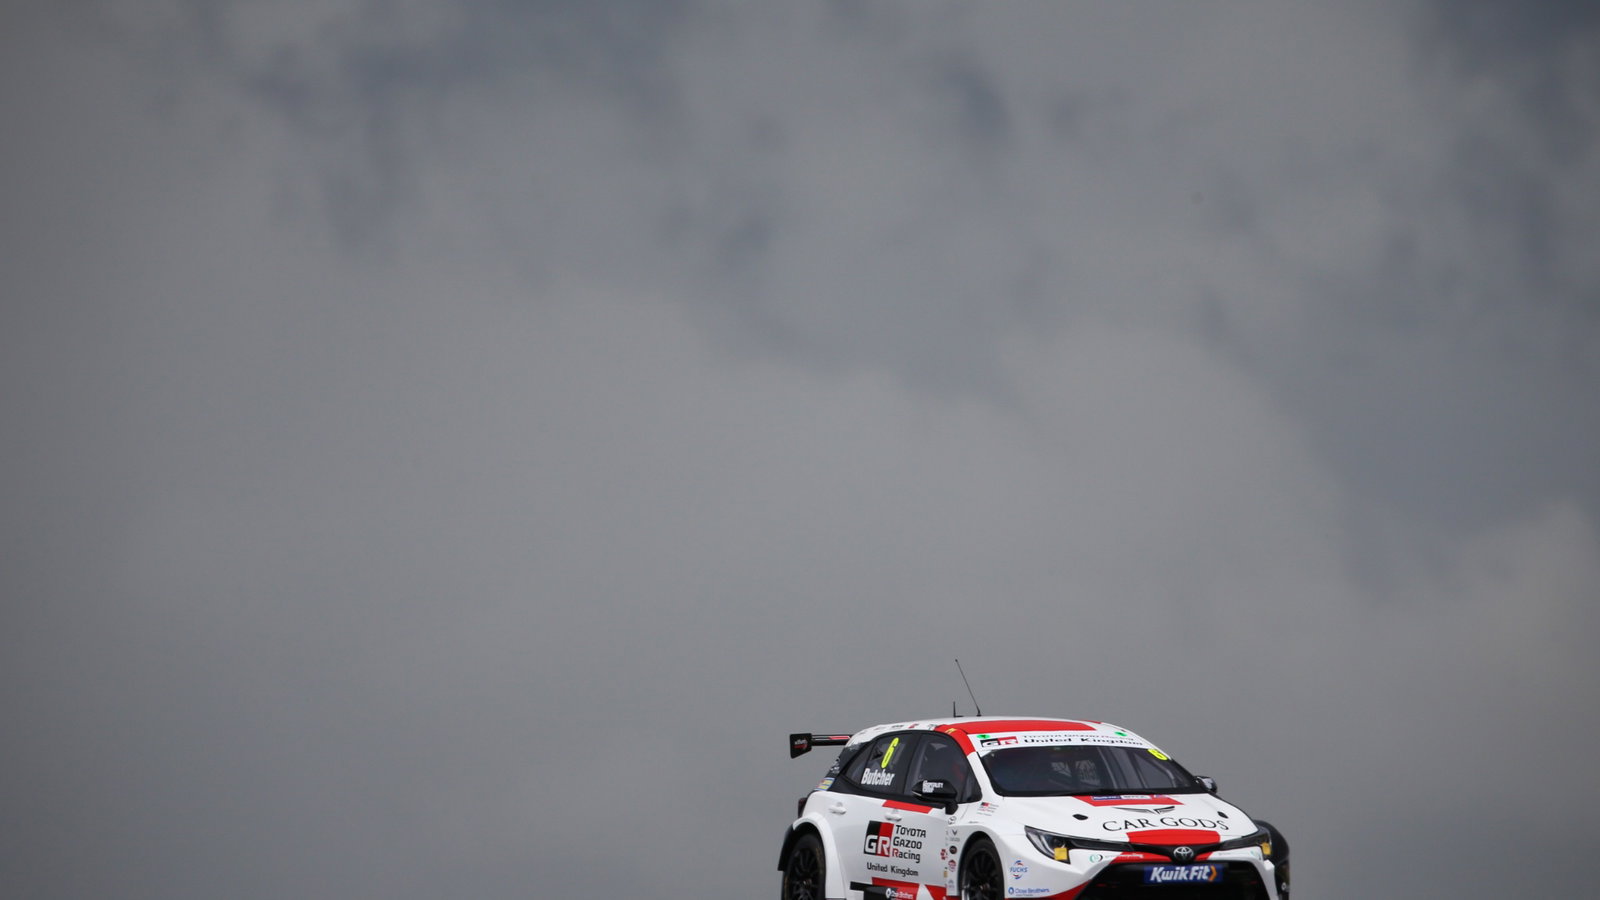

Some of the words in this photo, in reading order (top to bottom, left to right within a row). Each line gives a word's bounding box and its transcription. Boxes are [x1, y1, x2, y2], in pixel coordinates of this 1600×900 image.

[1080, 737, 1143, 746] Kingdom
[881, 737, 899, 769] 6
[861, 767, 895, 786] Butcher
[895, 824, 927, 838] TOYOTA
[1102, 817, 1154, 832] CAR
[1159, 816, 1229, 831] GODS
[864, 834, 891, 856] GR
[893, 836, 923, 850] GAZOO
[892, 848, 921, 864] Racing
[866, 862, 888, 873] United
[890, 865, 919, 878] Kingdom
